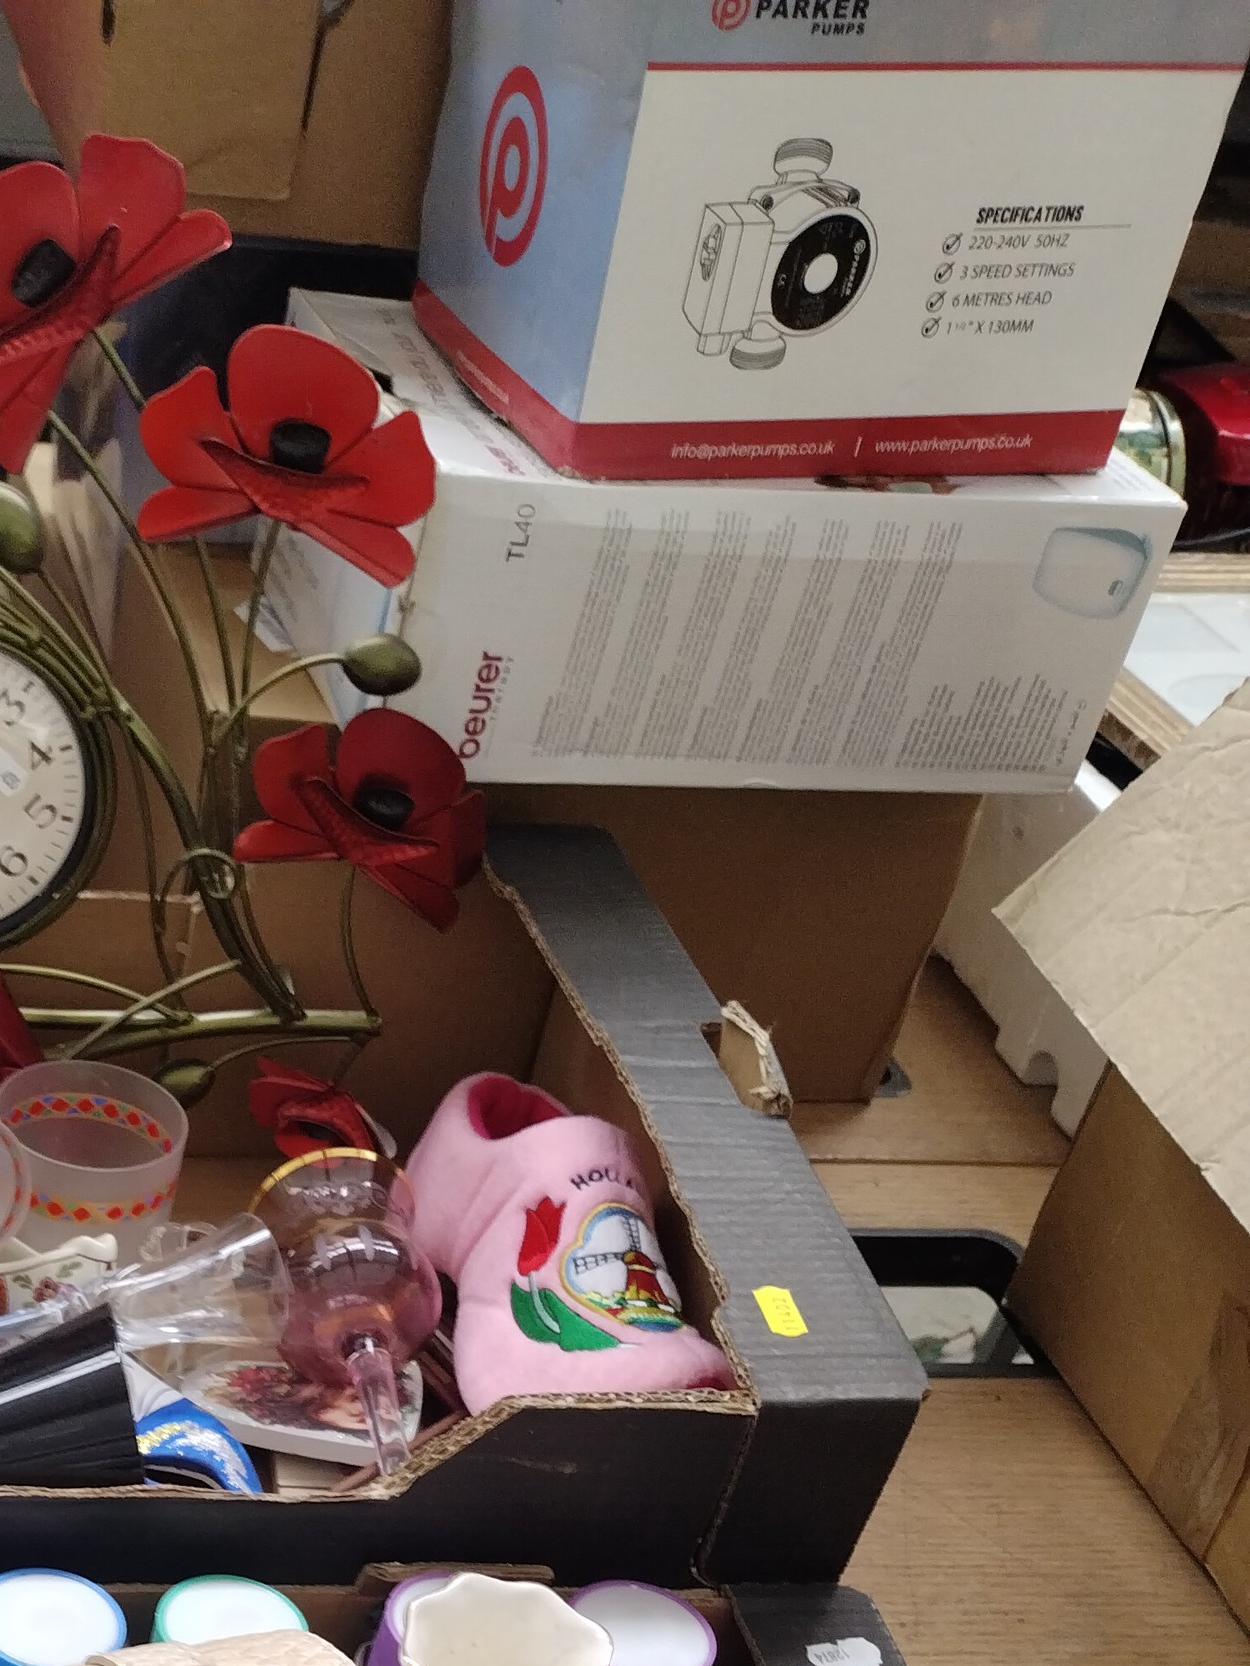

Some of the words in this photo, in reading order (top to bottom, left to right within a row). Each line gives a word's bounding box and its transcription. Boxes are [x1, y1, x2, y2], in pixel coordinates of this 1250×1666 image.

[755, 0, 869, 19] PARKER
[810, 22, 865, 36] PUMPS
[976, 205, 1084, 224] SPECIFICATIONS
[968, 234, 1030, 250] 220-240V
[1034, 233, 1070, 248] 50HZ
[959, 265, 968, 279] 3
[971, 264, 1012, 279] SPEED
[1014, 262, 1076, 278] SETTINGS
[952, 296, 960, 307] 6
[963, 292, 1014, 307] METRES
[1015, 290, 1052, 305] HEAD
[975, 320, 985, 334] X
[988, 319, 1034, 333] 130MM
[670, 440, 836, 460] info@parkerpumps.co.uk
[874, 434, 1033, 454] www.parkerpumps.co.uk
[506, 503, 537, 562] TL40
[29, 741, 53, 770] 4
[23, 794, 57, 829] 5
